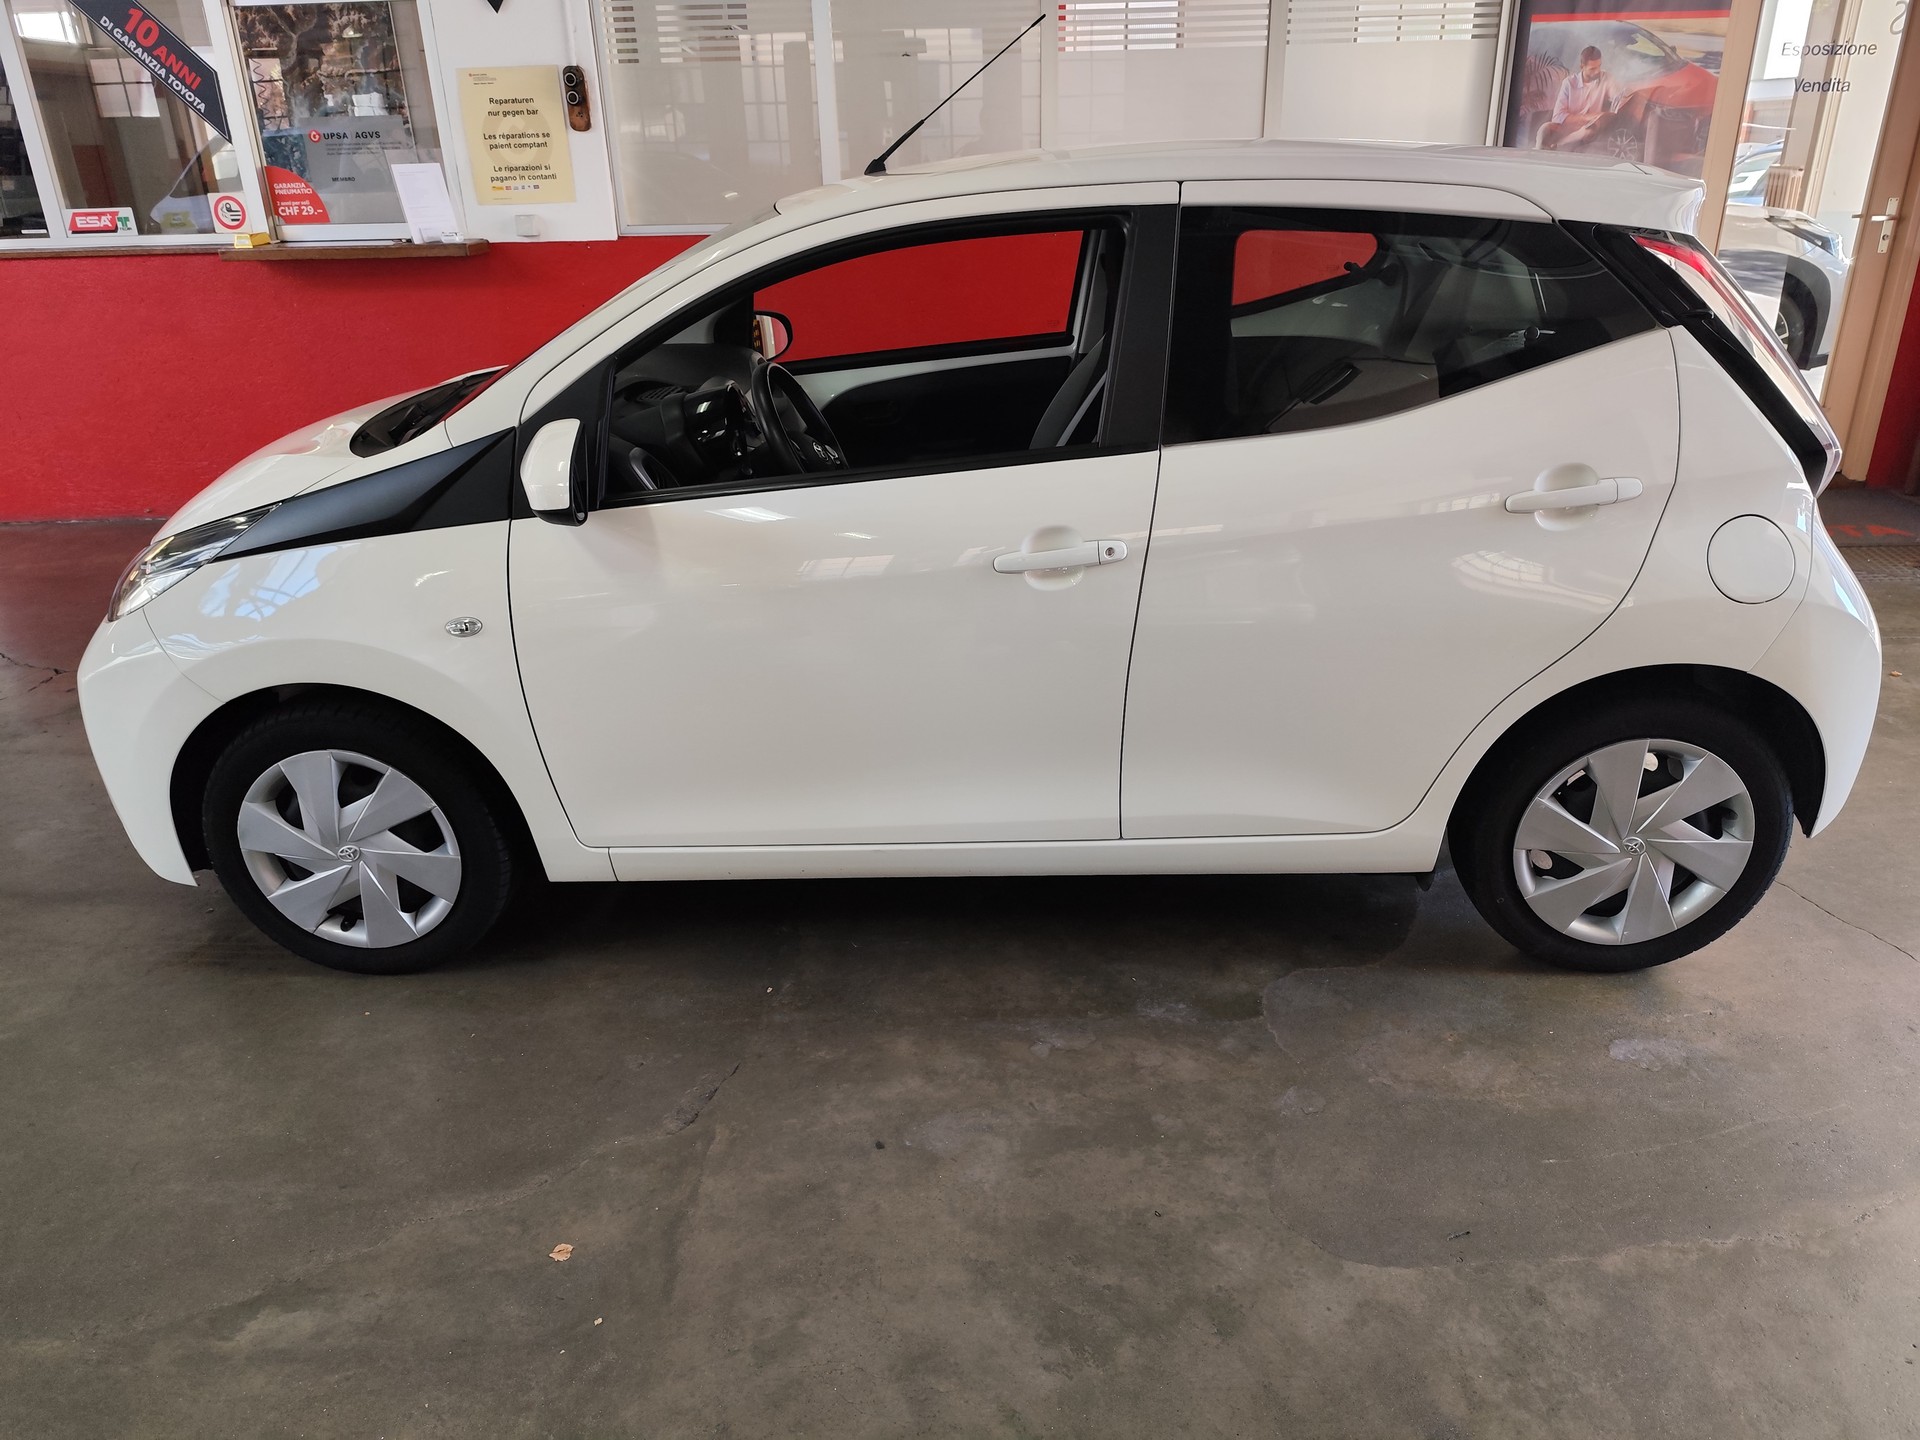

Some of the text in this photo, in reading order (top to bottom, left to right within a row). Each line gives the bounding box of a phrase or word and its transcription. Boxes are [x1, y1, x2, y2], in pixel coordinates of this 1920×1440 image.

[124, 7, 202, 90] 10 ANNI
[100, 16, 206, 114] DI GARANZIA TOYOTA
[1794, 78, 1851, 93] Vendita
[488, 97, 535, 106] Reparaturen
[502, 109, 525, 118] gegen
[526, 108, 539, 116] bar
[323, 132, 349, 140] UPSA
[355, 131, 381, 139] AGVS
[498, 132, 540, 141] réparations
[489, 141, 548, 151] paient comptant
[504, 164, 543, 173] riparazioni
[490, 173, 557, 183] pagano in contanti
[278, 206, 300, 216] CHF
